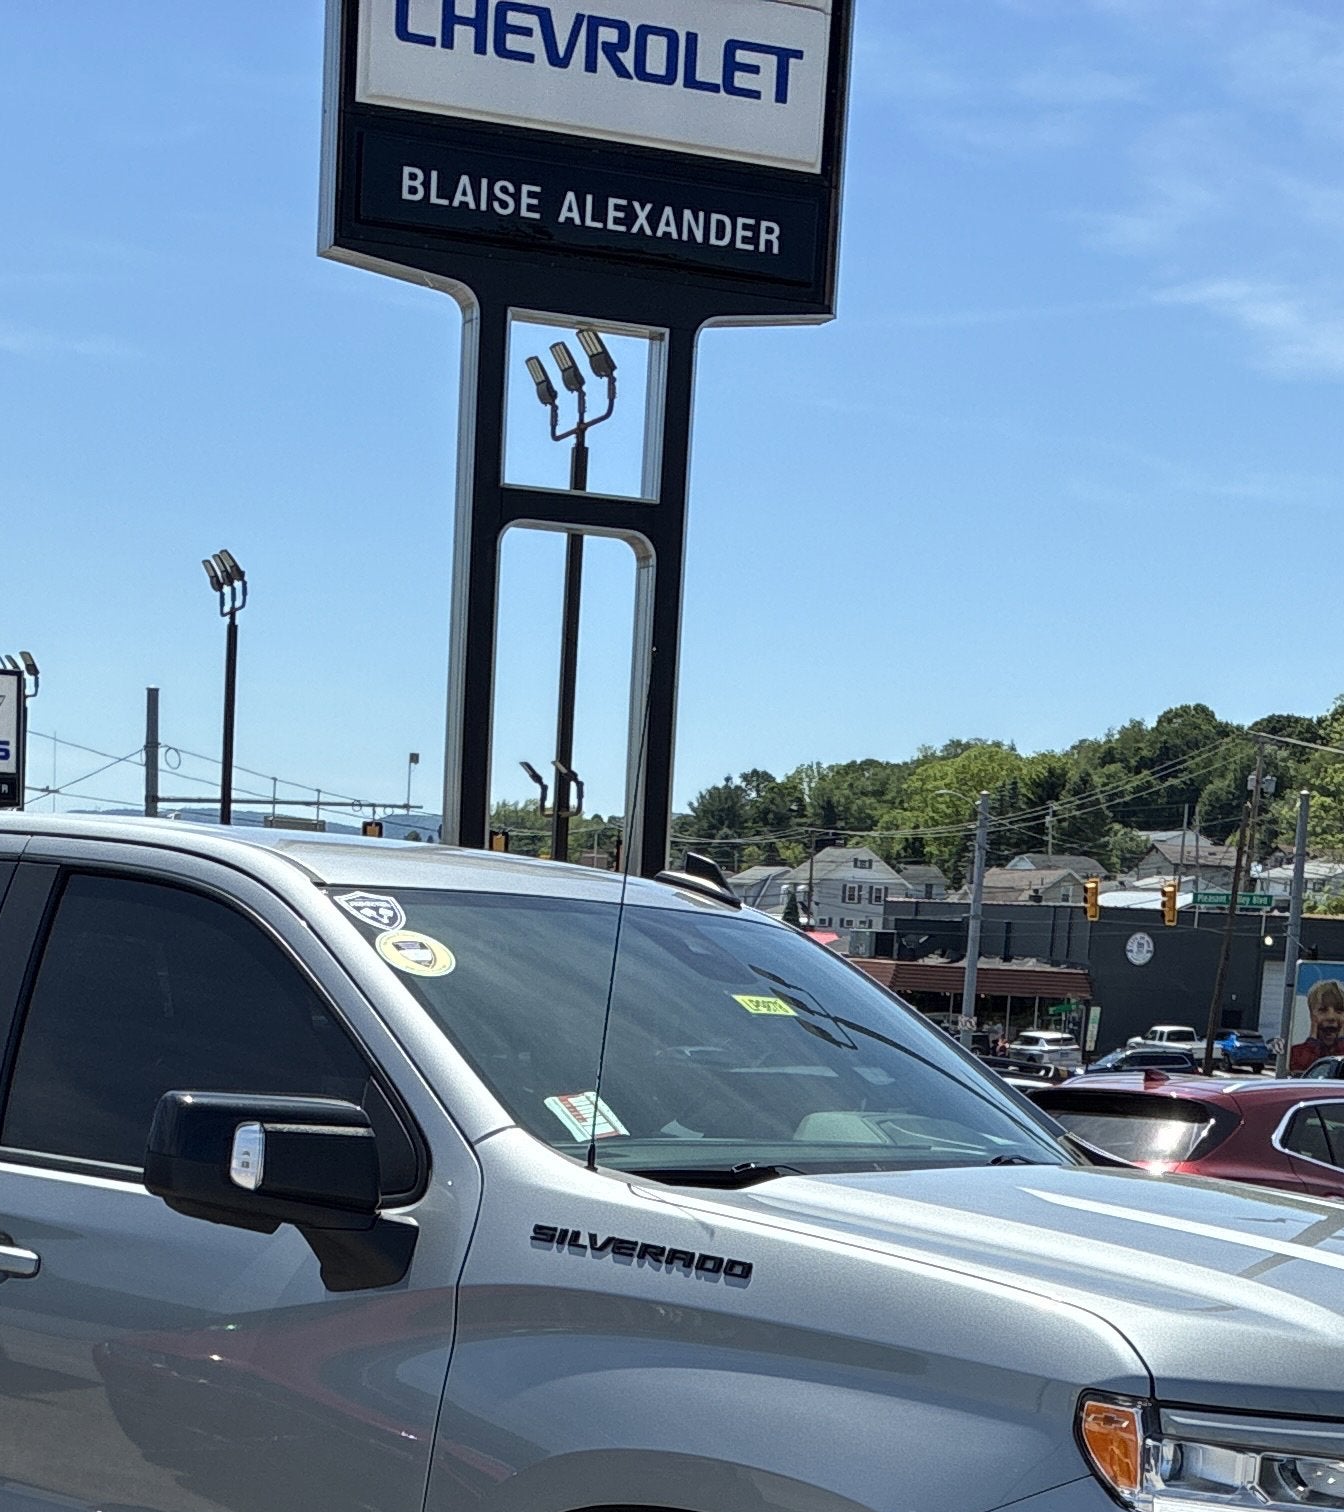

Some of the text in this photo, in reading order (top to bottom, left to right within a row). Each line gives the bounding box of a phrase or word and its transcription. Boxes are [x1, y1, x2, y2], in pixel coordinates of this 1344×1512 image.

[394, 0, 804, 104] CHEVROLET
[401, 165, 781, 256] BLAISE ALEXANDER
[529, 1223, 754, 1281] SILVERADO
